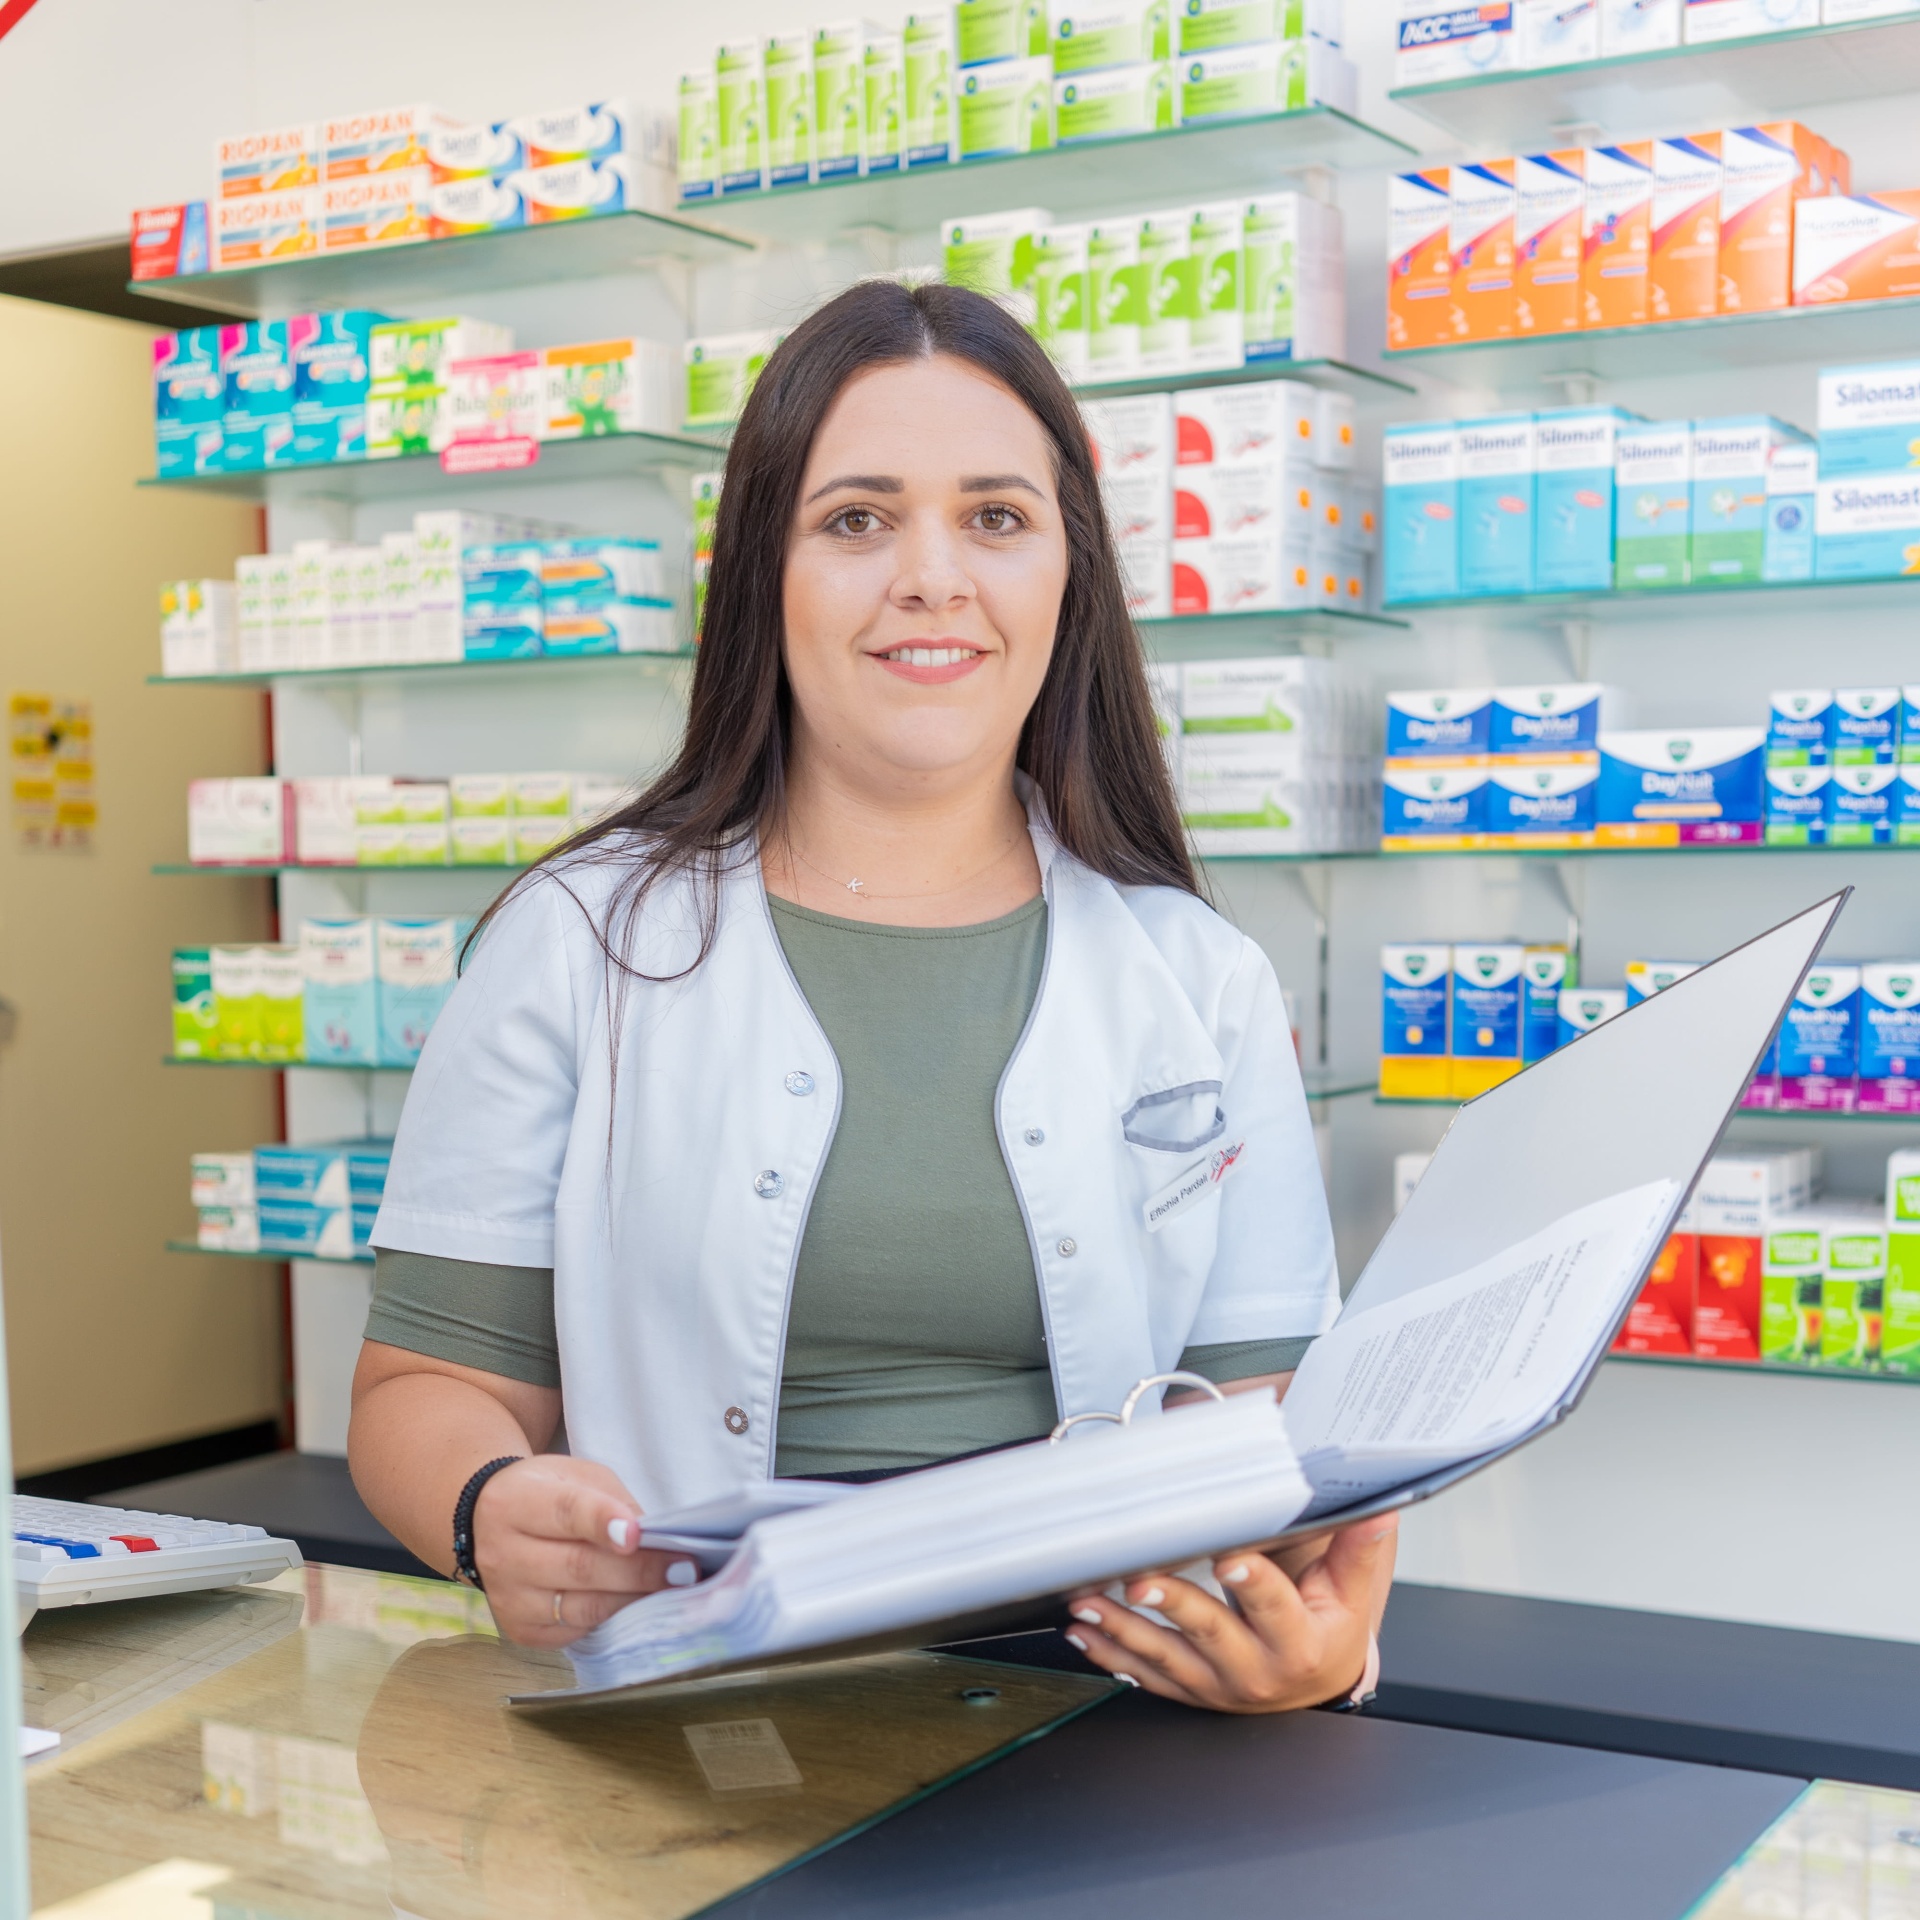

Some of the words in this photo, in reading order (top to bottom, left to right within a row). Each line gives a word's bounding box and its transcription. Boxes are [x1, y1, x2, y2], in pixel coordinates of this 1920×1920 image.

[1401, 15, 1451, 46] ACC
[326, 109, 414, 143] RIOPAN
[220, 133, 303, 161] RIOPAN
[325, 178, 412, 210] RIOPAN
[220, 199, 303, 227] RIOPAN
[1836, 381, 1920, 408] Siloma
[1462, 433, 1527, 452] Silomat
[1539, 426, 1605, 445] Silomat
[1696, 436, 1762, 456] Silomat
[1391, 441, 1453, 461] Silomat
[1621, 443, 1684, 462] Silomat
[1868, 1008, 1920, 1026] MediNa
[1150, 1196, 1179, 1221] Eftichia
[1180, 1172, 1208, 1200] Pardali
